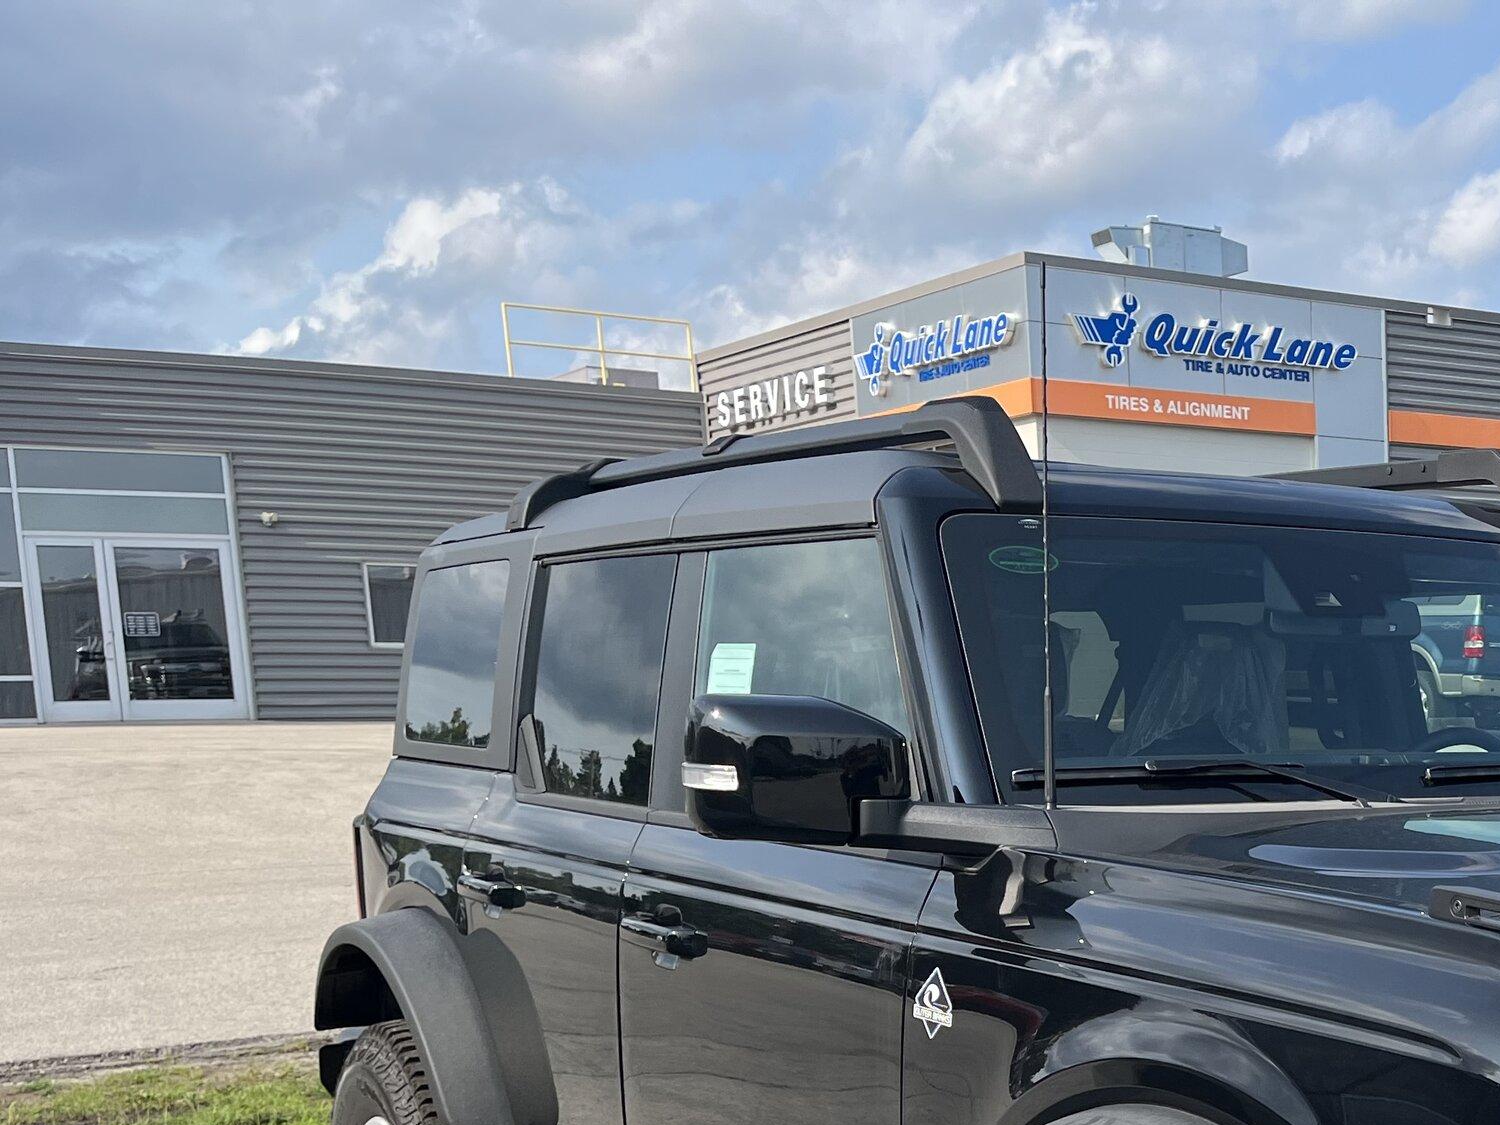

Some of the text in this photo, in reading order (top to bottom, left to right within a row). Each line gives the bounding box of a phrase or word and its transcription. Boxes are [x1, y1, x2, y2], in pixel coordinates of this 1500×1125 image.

[889, 312, 1007, 375] Quick Lane
[1143, 312, 1358, 370] Quick Lane
[716, 366, 829, 427] SERVICE
[1183, 358, 1311, 383] TIRE & AUTO CENTER
[1105, 394, 1250, 420] TIRES & ALIGNMENT
